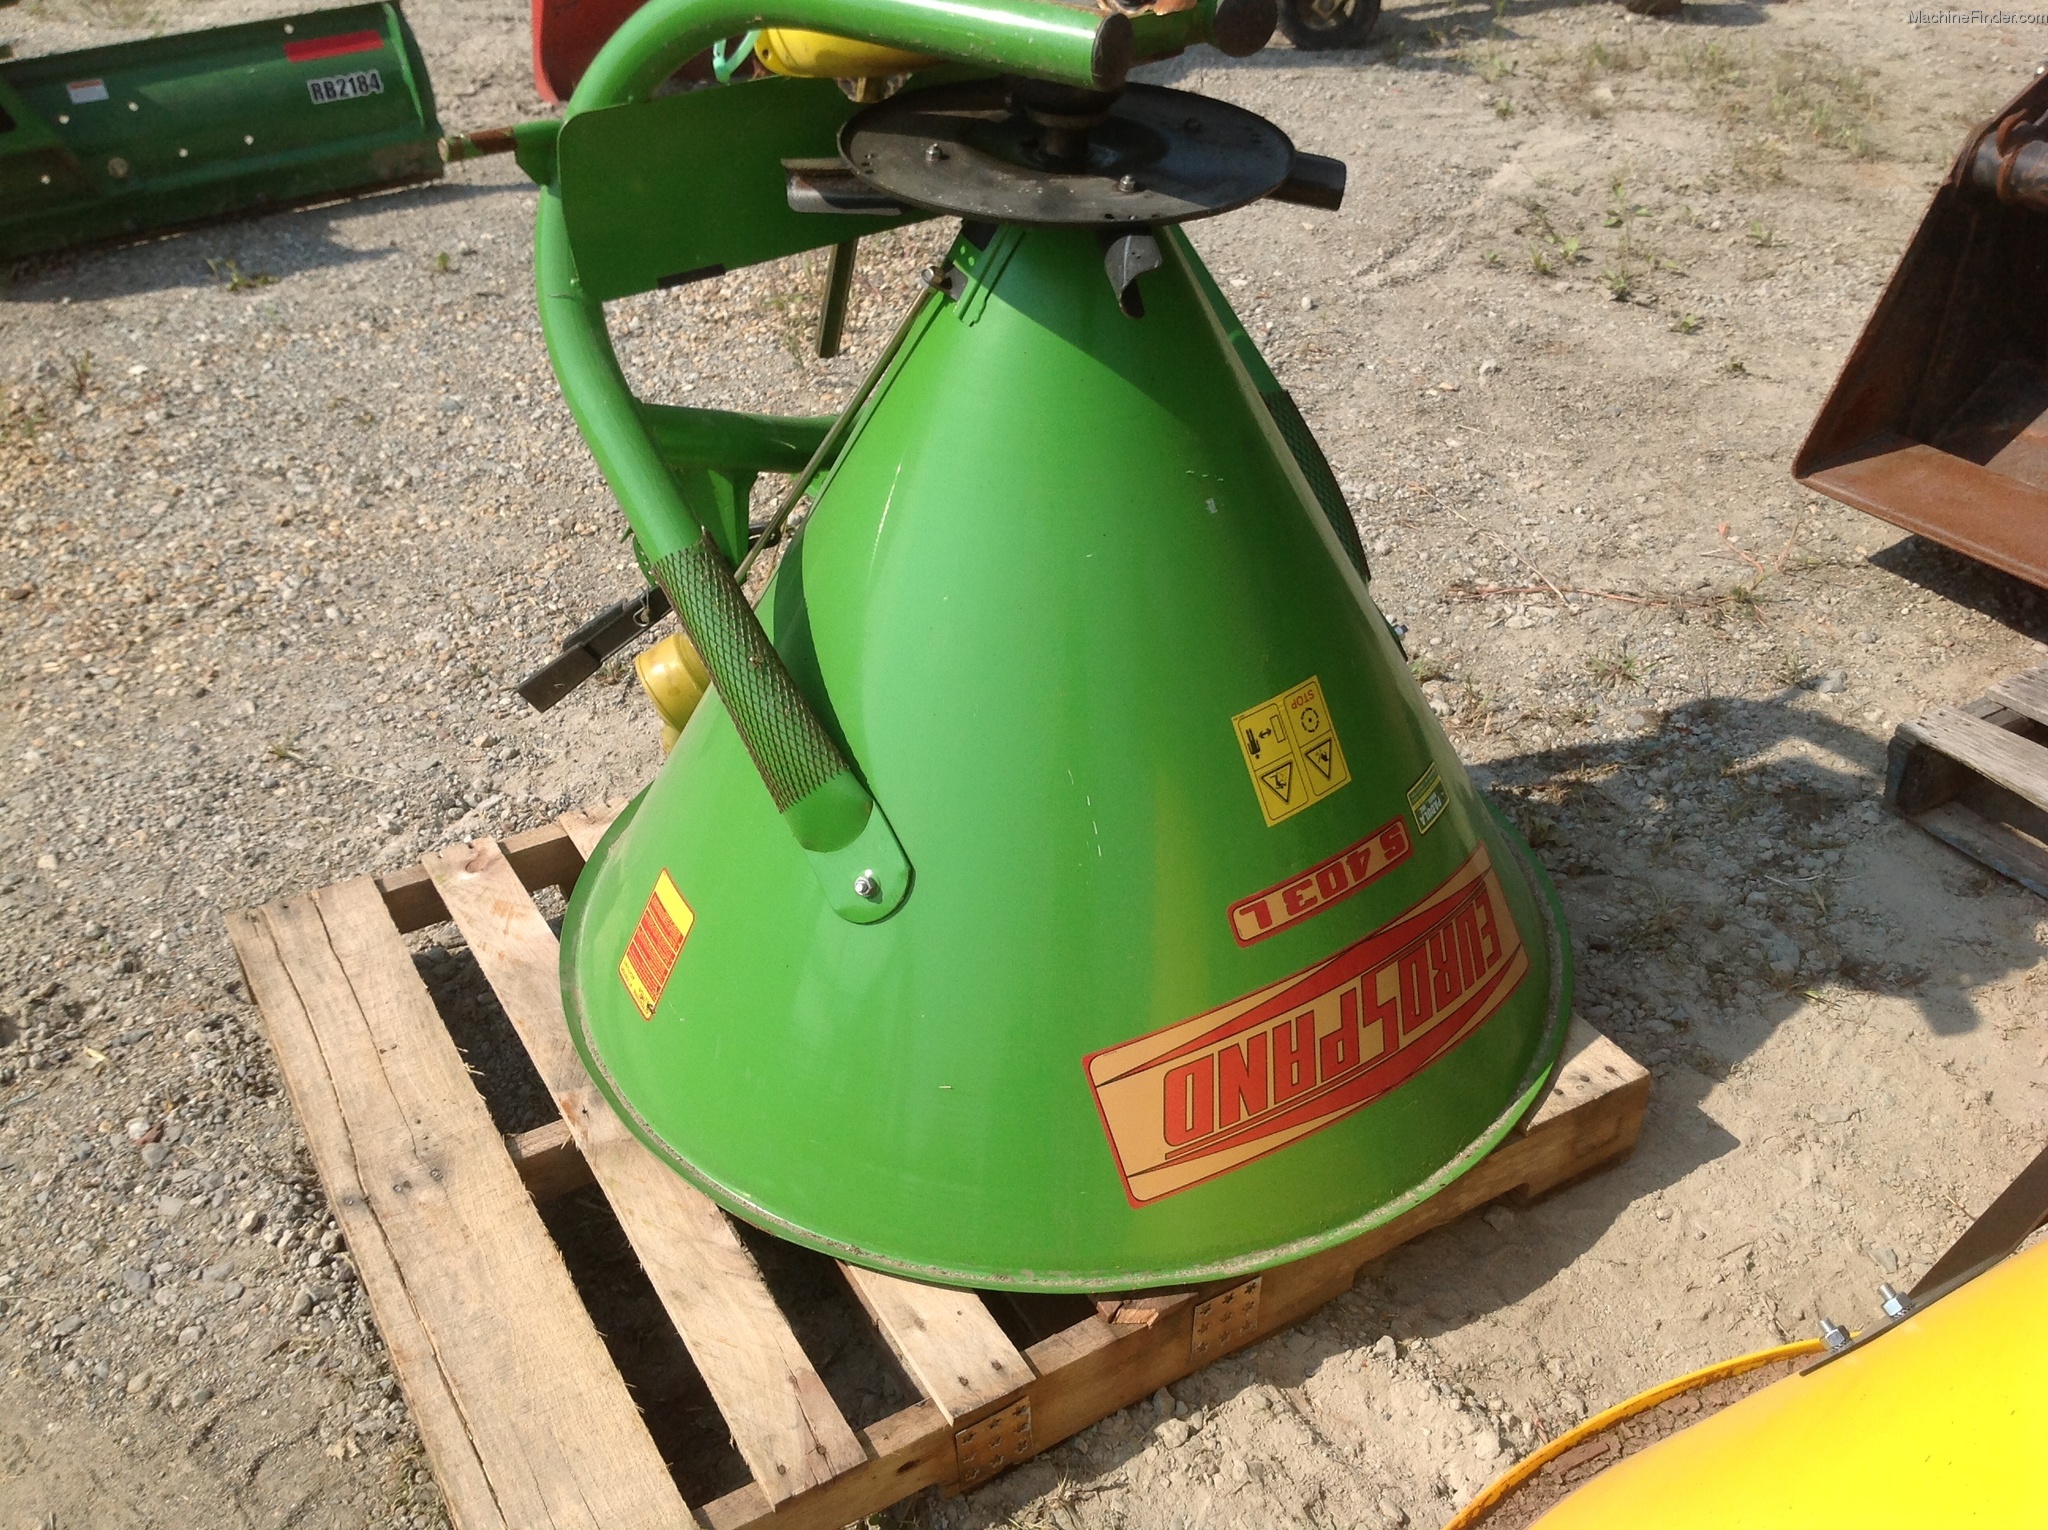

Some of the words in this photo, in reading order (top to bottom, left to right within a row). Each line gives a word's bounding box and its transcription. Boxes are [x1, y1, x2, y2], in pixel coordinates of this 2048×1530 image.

[310, 72, 381, 101] RB2184
[1291, 689, 1315, 710] STOP
[1163, 880, 1502, 1147] EUROSPAND
